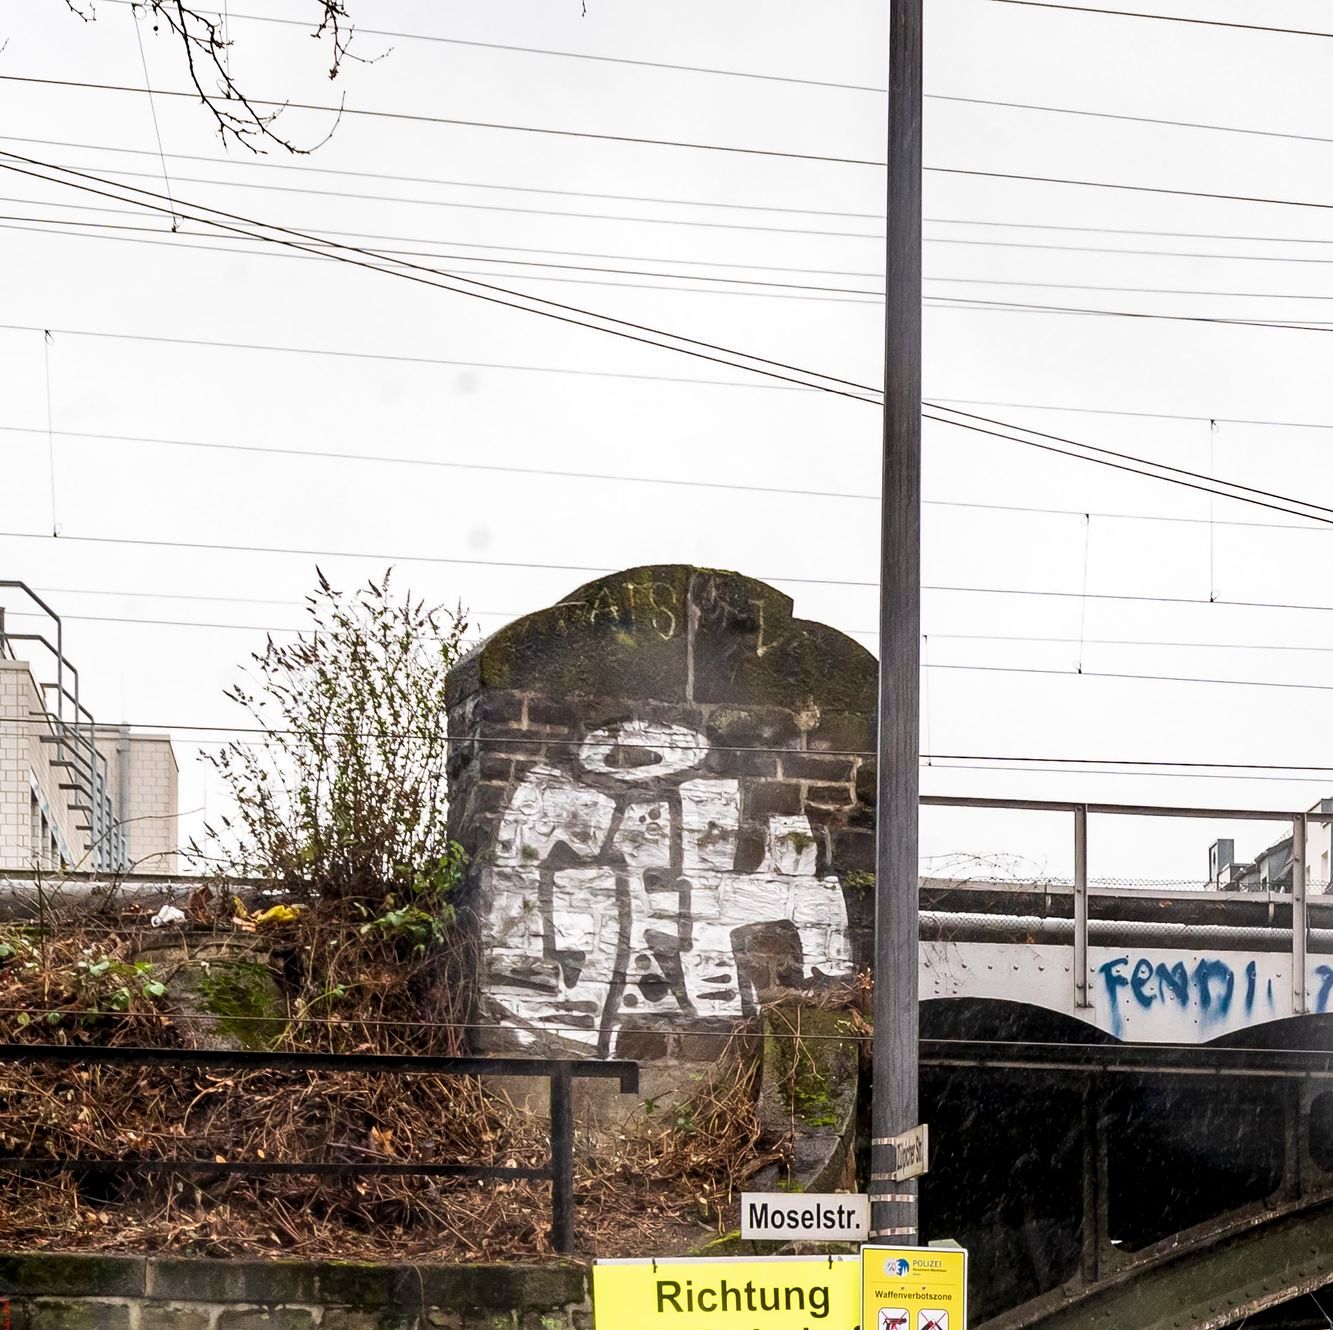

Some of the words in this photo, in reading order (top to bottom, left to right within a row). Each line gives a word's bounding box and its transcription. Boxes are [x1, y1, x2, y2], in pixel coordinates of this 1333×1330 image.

[749, 1203, 861, 1230] Moselstr.
[656, 1280, 830, 1319] Richtung
[875, 1290, 952, 1301] Waffenverbotszone
